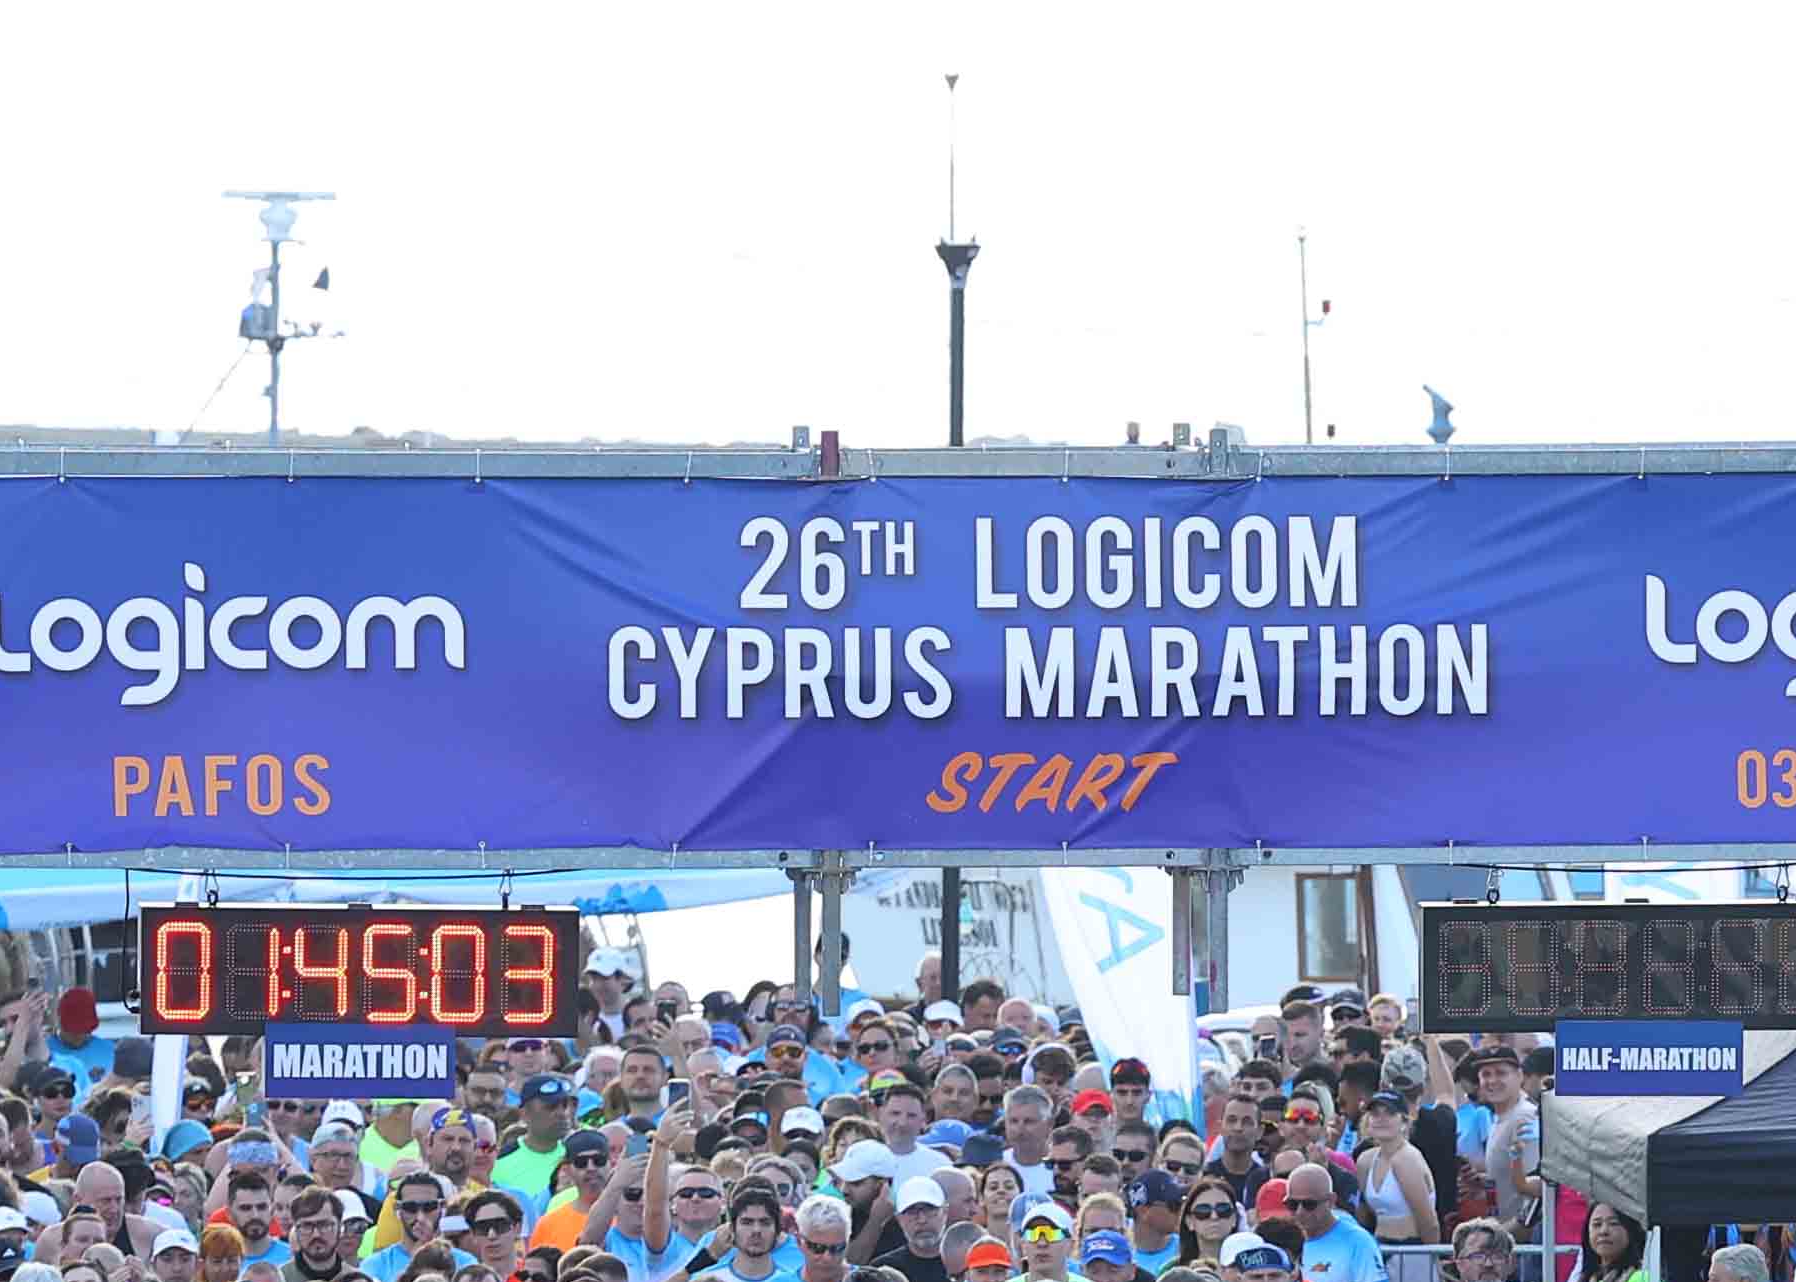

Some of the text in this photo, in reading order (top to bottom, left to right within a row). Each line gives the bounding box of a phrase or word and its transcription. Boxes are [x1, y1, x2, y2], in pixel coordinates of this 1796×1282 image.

[739, 515, 1358, 610] 26TH LOGICOM
[607, 623, 1489, 720] CYPRUS MARATHON
[113, 753, 332, 817] PAFOS
[926, 750, 1177, 814] START
[273, 1042, 448, 1081] MARATHON
[1562, 1045, 1738, 1074] HALF-MARATHON
